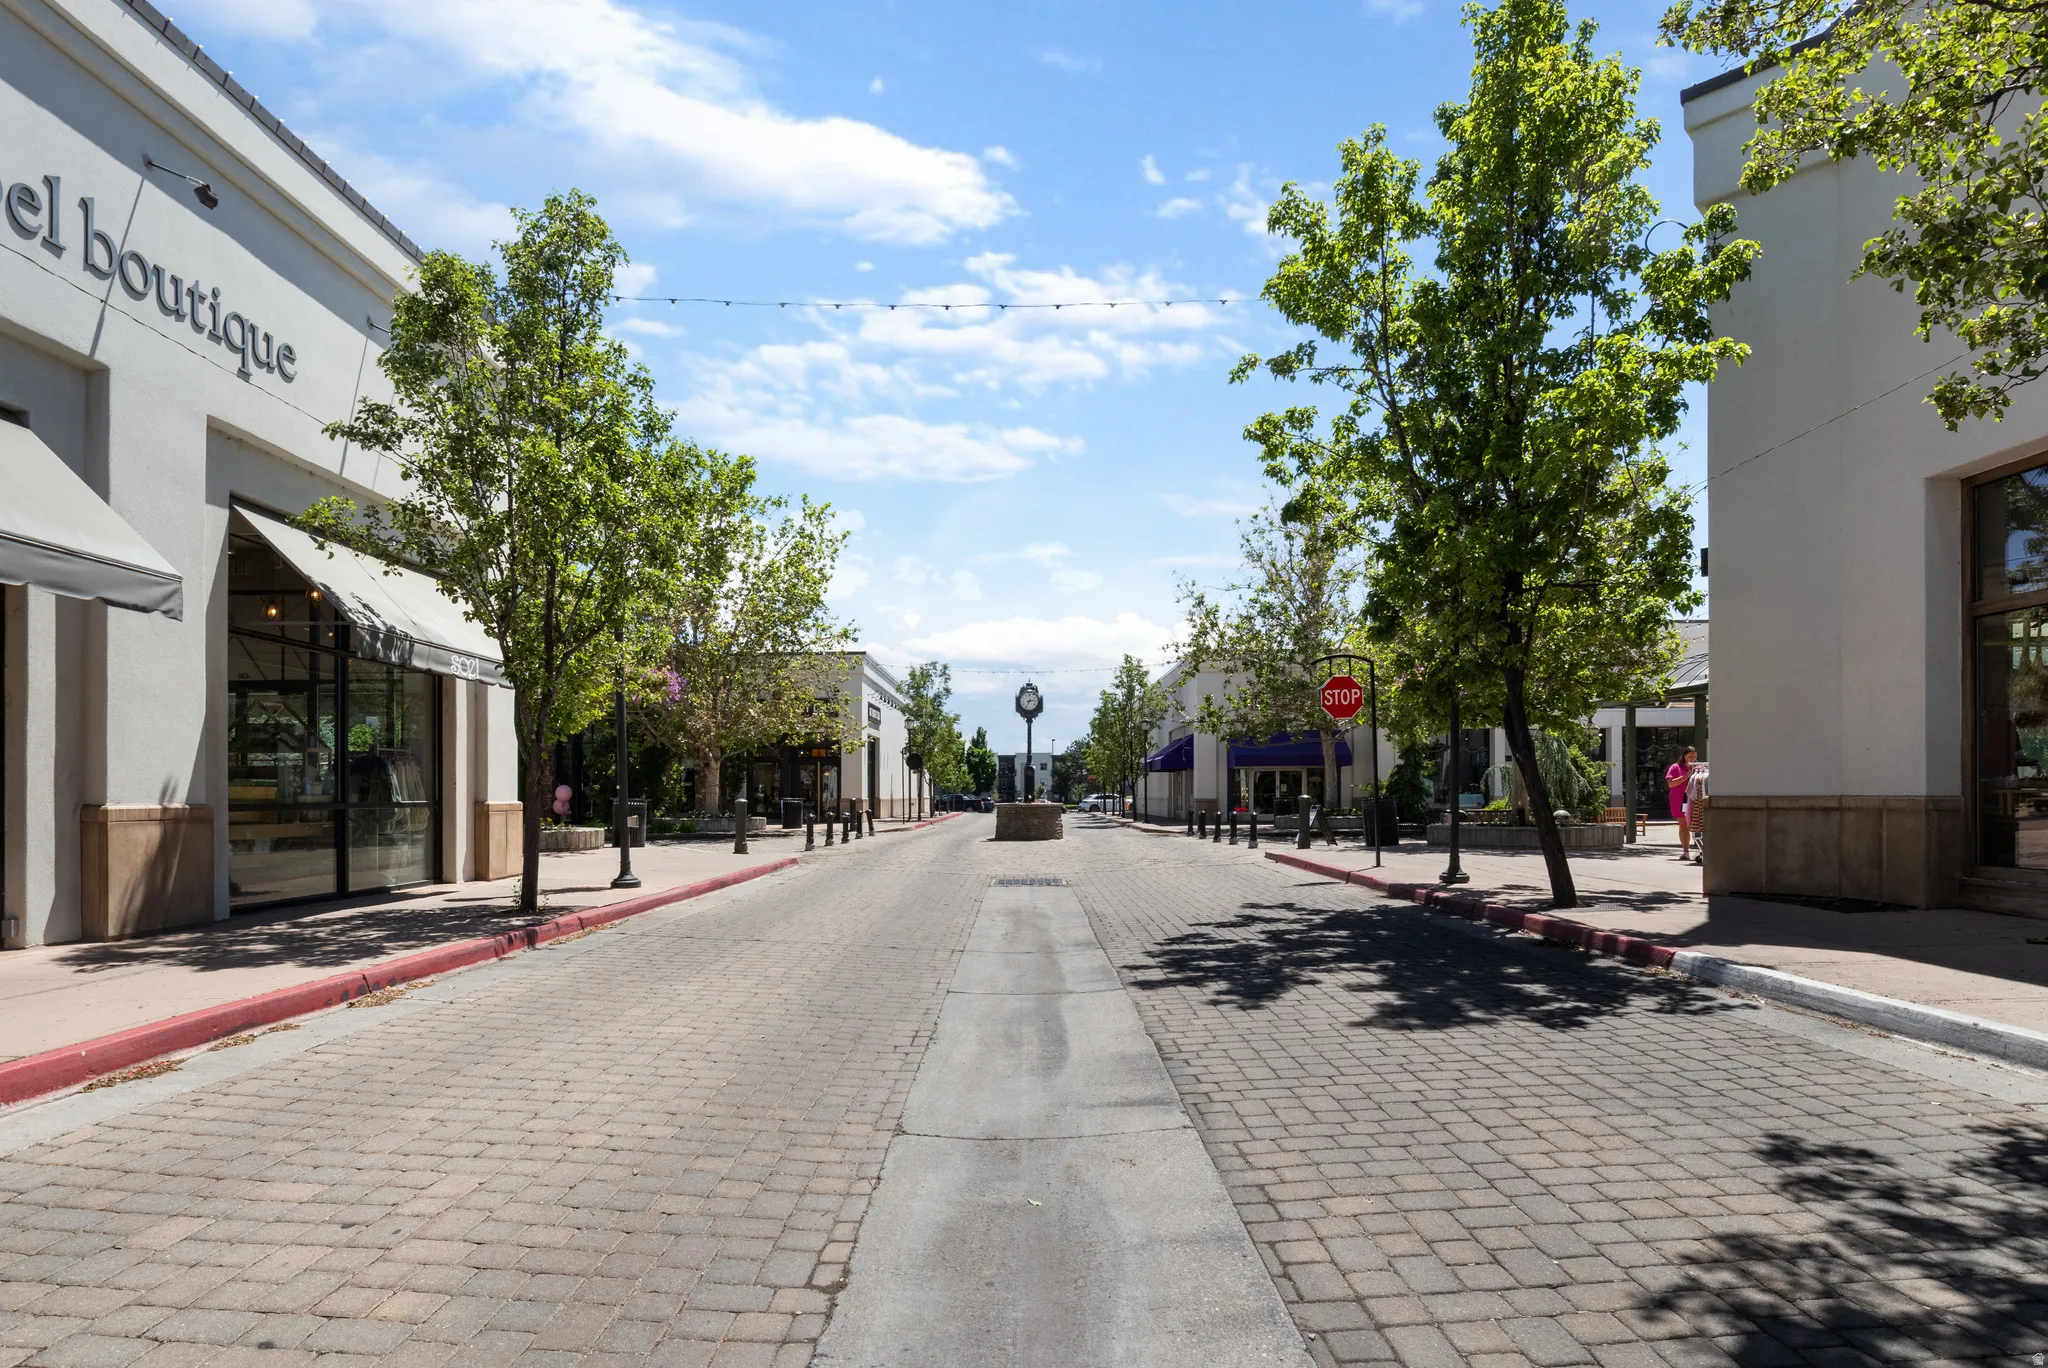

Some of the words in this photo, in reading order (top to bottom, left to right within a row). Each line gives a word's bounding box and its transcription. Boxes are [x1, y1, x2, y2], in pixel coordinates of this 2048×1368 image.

[0, 175, 66, 250] el
[78, 197, 297, 380] boutique
[1324, 688, 1361, 705] STOP
